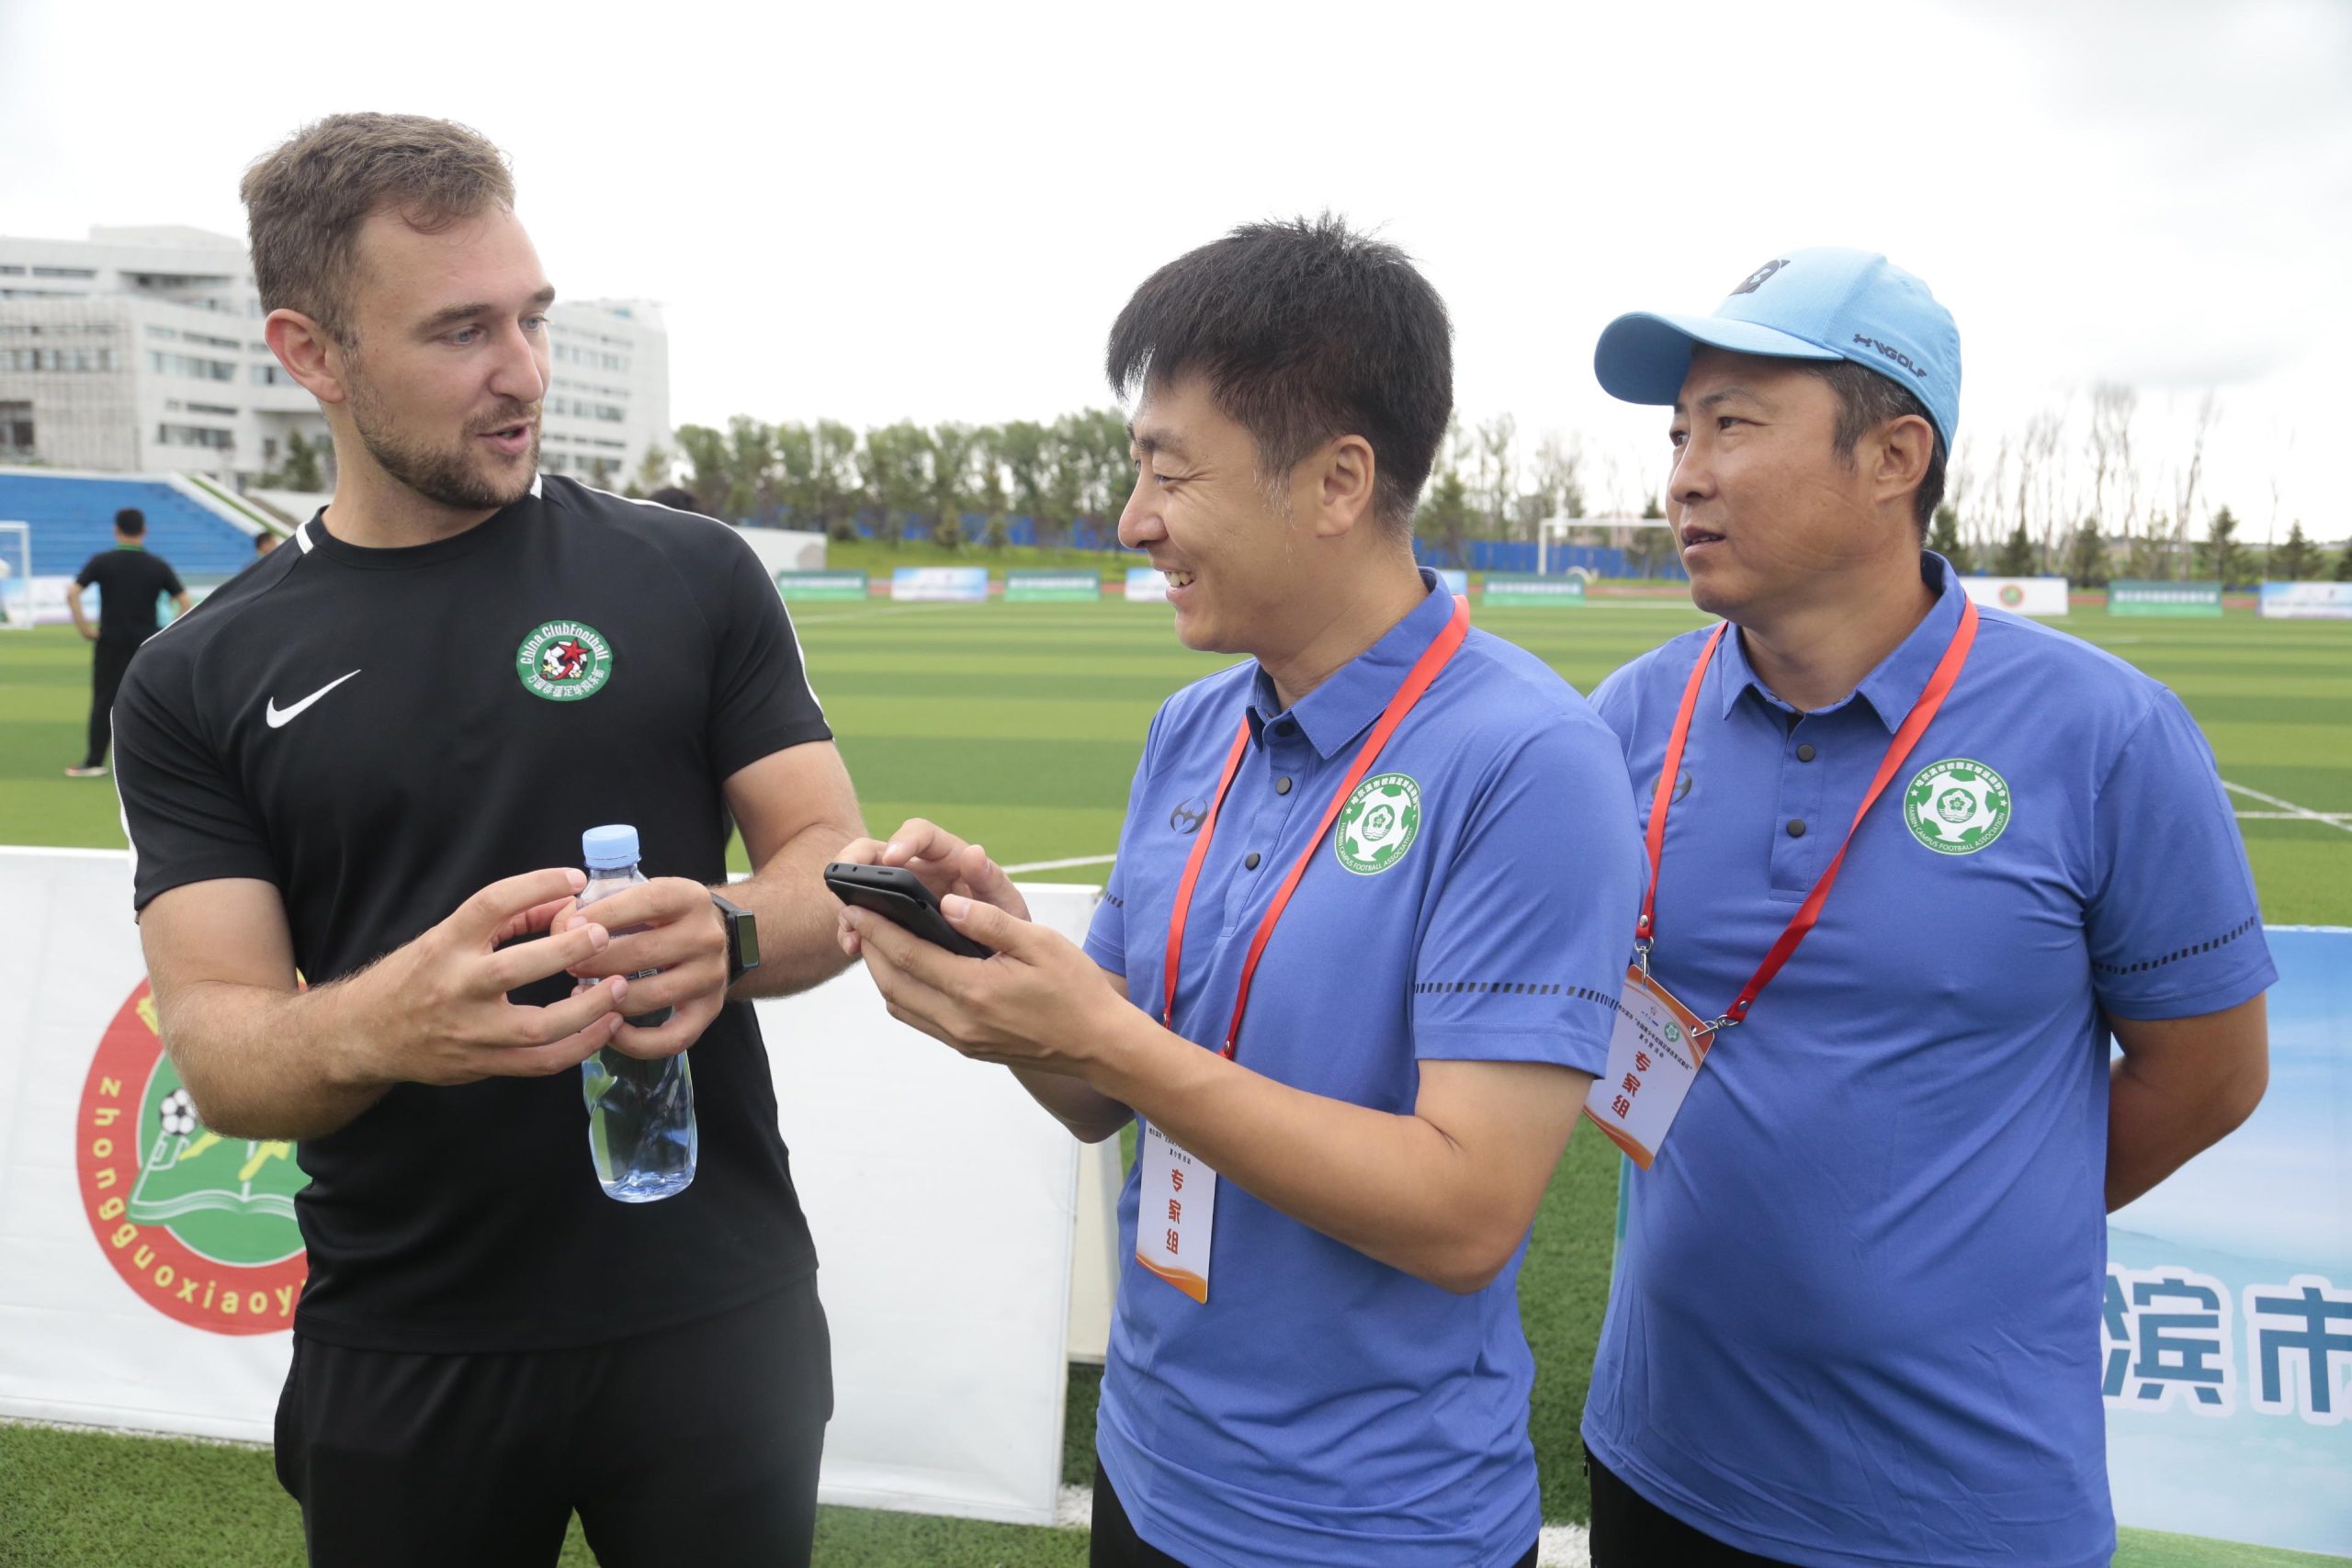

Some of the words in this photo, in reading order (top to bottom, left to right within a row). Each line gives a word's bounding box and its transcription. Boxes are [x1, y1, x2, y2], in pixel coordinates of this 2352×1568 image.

[520, 633, 544, 664] China
[542, 623, 609, 660] ClubFootball
[1908, 804, 1918, 828] HARBIN
[1916, 828, 1939, 847] CAMPUS
[1939, 842, 1974, 852] FOOTBALL
[1974, 812, 2006, 846] ASSOCIATION
[1352, 862, 1383, 872] FOOTBALL
[1611, 1051, 1652, 1120] 专家组
[93, 1077, 306, 1317] zhongguoxiaoy
[1166, 1168, 1184, 1256] 专家组
